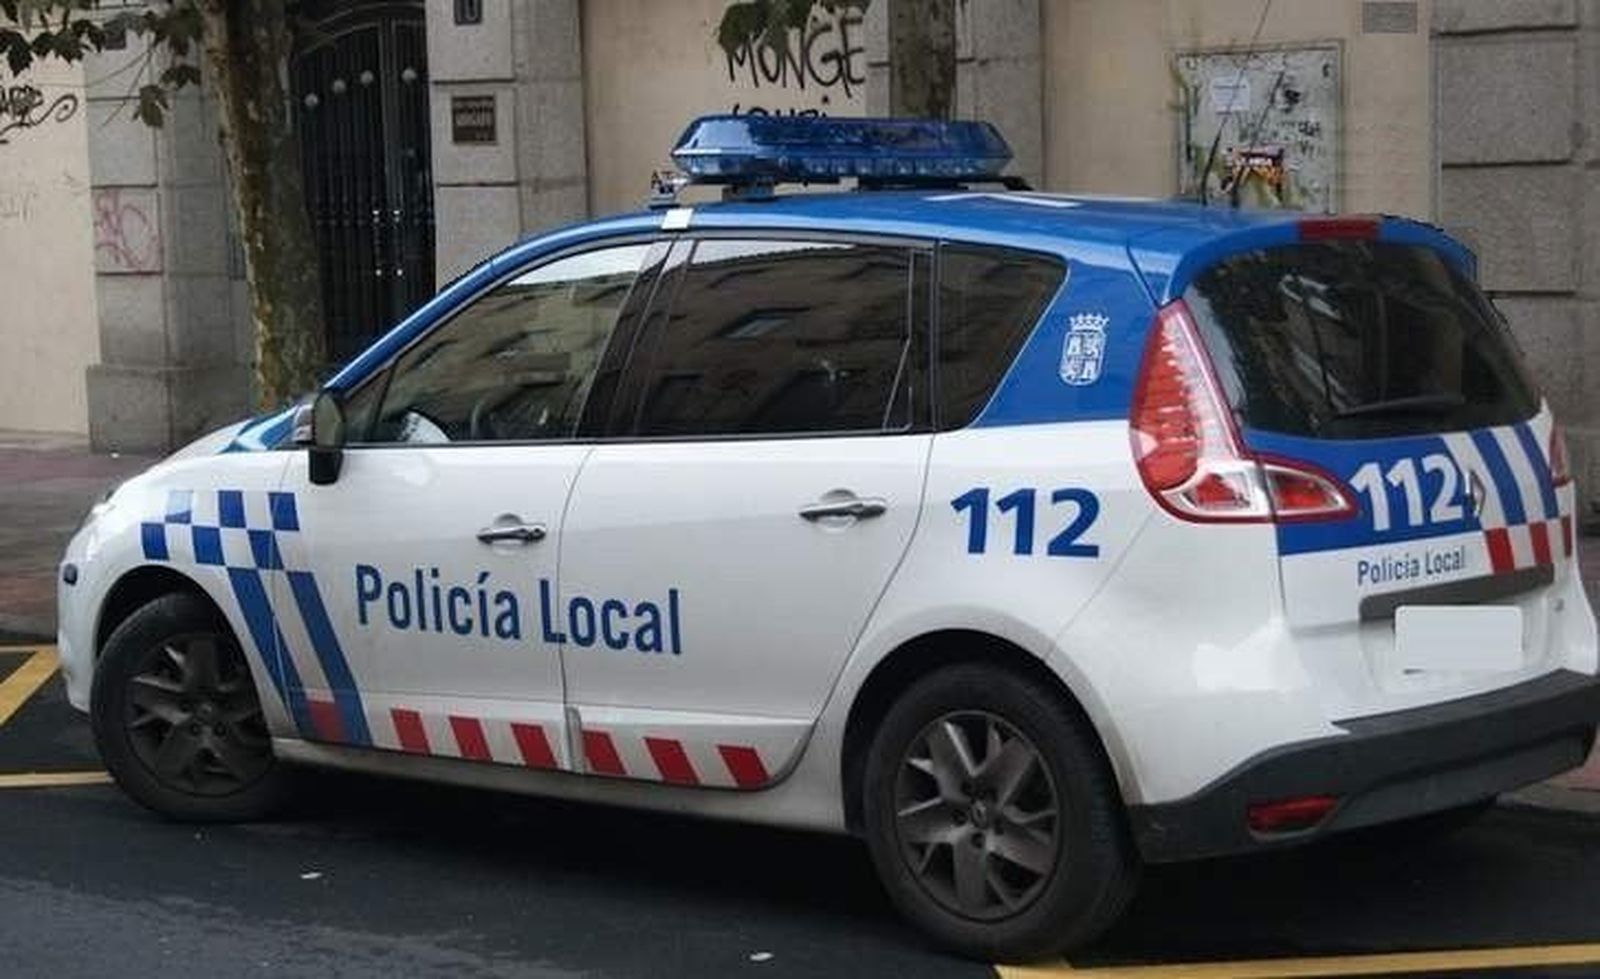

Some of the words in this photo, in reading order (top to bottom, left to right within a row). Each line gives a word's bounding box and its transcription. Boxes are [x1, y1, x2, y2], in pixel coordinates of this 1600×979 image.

[726, 17, 866, 98] MONGE
[950, 487, 1101, 558] 112
[1349, 453, 1463, 532] 112
[1425, 545, 1465, 575] Local
[355, 563, 521, 640] Policía
[539, 578, 682, 656] Local
